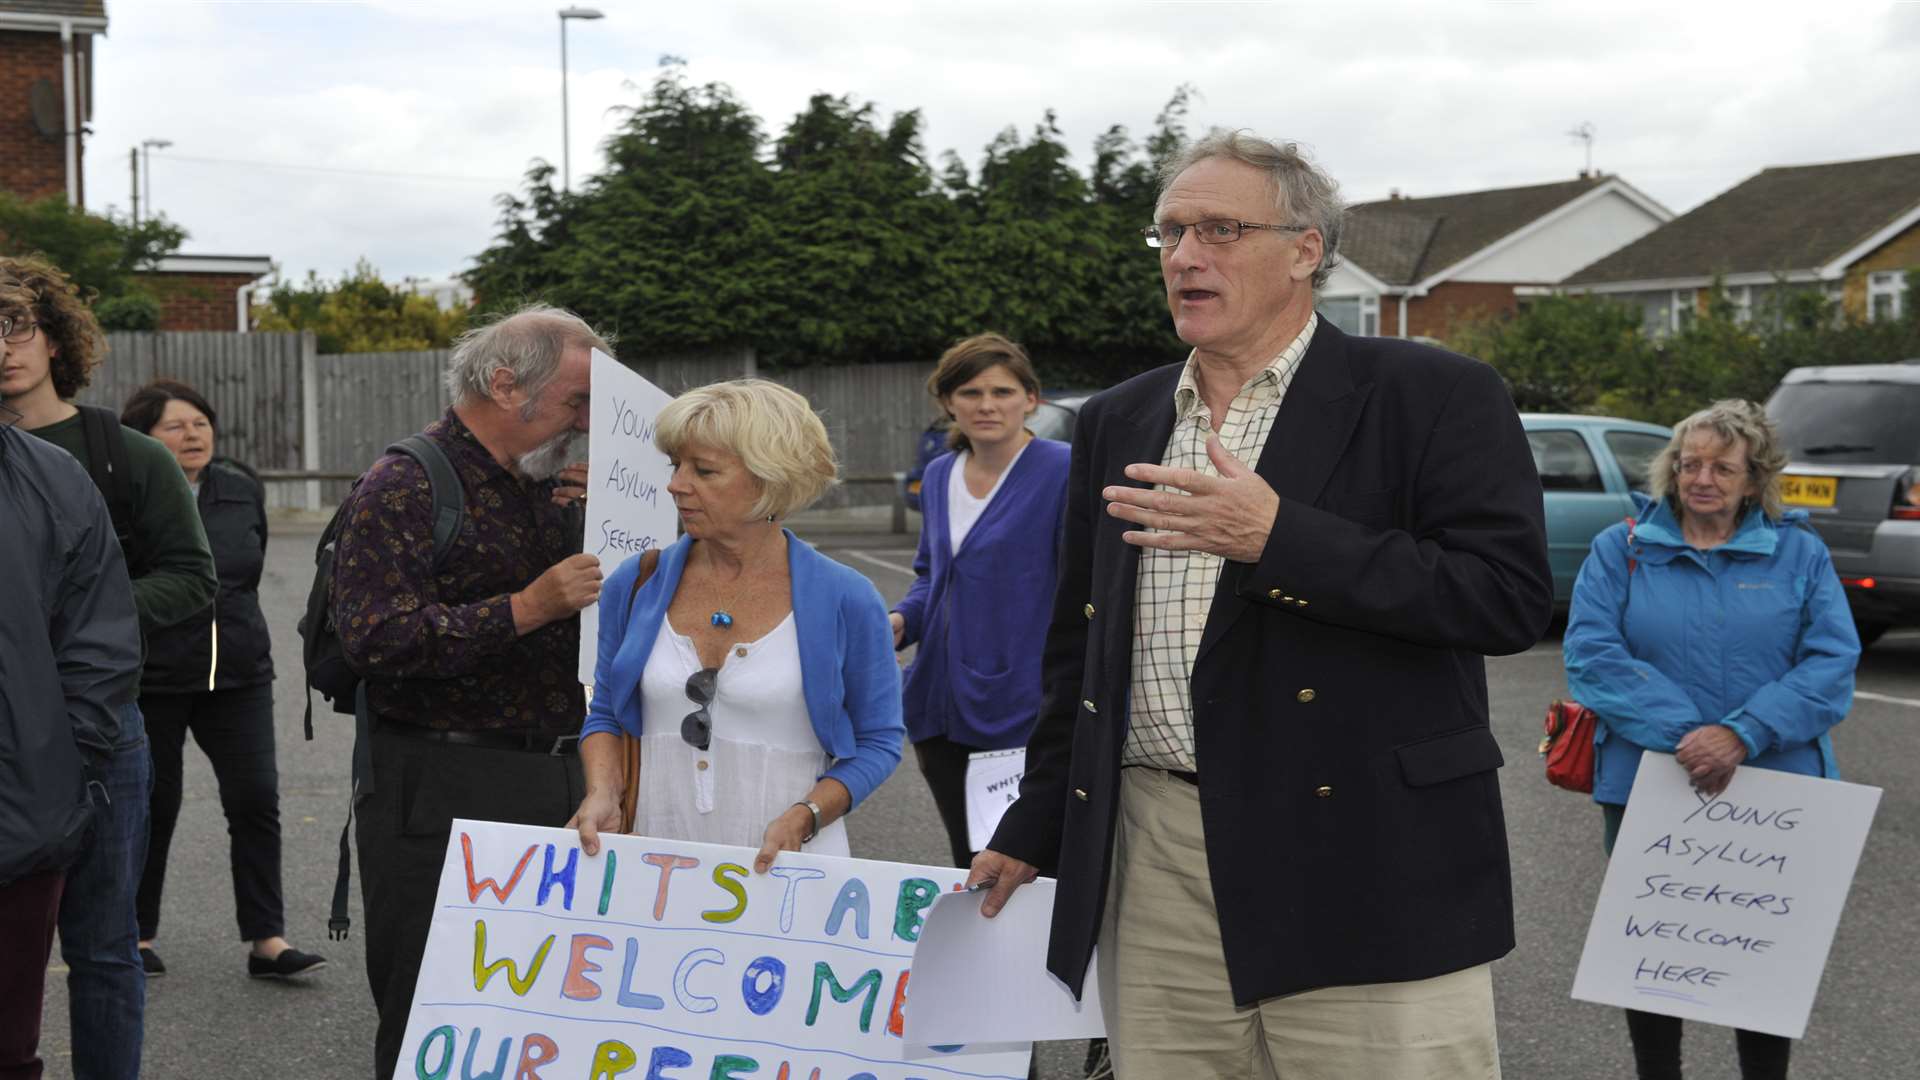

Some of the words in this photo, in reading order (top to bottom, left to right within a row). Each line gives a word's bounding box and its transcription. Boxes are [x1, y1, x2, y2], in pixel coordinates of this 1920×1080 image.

[606, 459, 657, 508] ASYLUM
[1683, 788, 1803, 830] YOUNG
[1643, 834, 1787, 873] ASYLUM
[461, 832, 963, 943] WHITSTAB
[1636, 874, 1795, 915] SEEKERS
[1625, 915, 1775, 953] WELCOME
[1634, 957, 1730, 987] HERE
[415, 1024, 560, 1080] OUR
